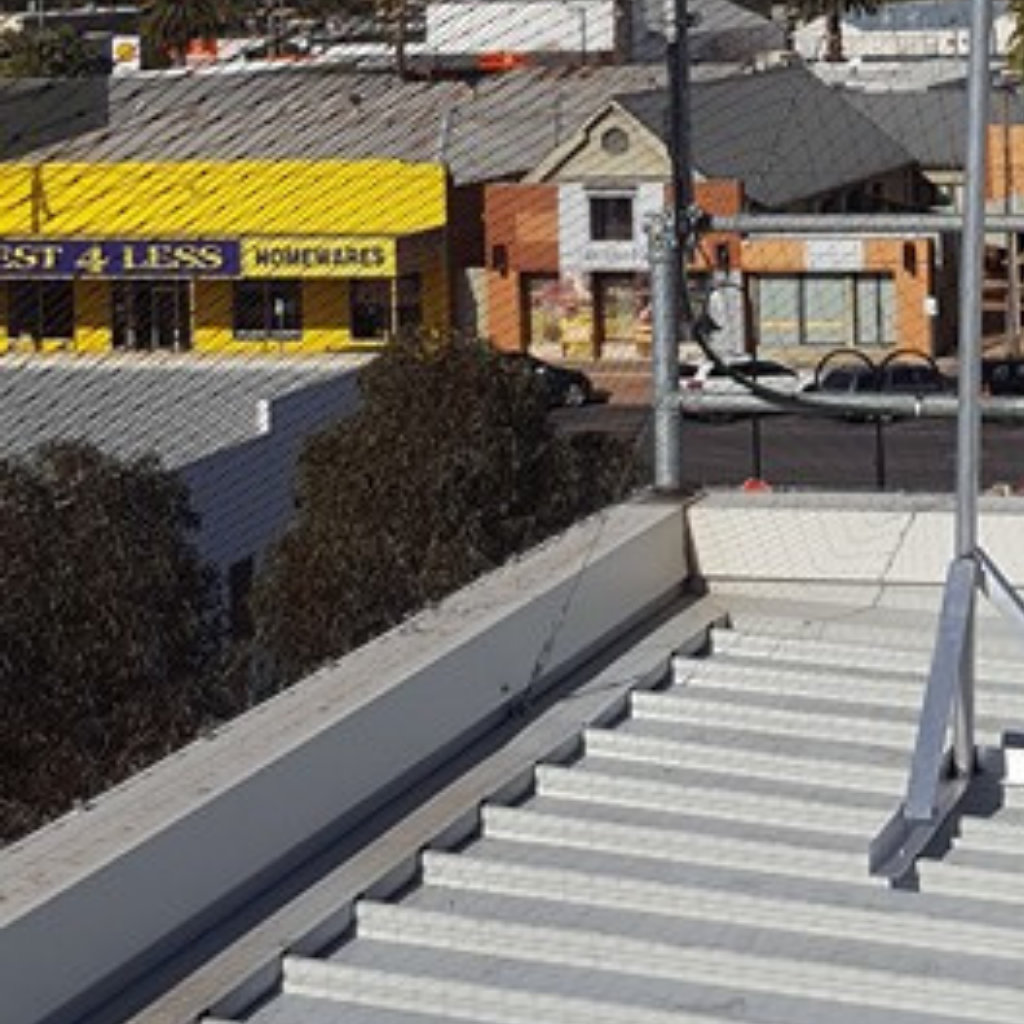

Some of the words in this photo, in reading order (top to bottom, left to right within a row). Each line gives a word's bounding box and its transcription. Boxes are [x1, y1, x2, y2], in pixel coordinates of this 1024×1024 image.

[75, 244, 109, 273] 4
[122, 243, 224, 270] LESS
[255, 246, 386, 266] HOMEWARES
